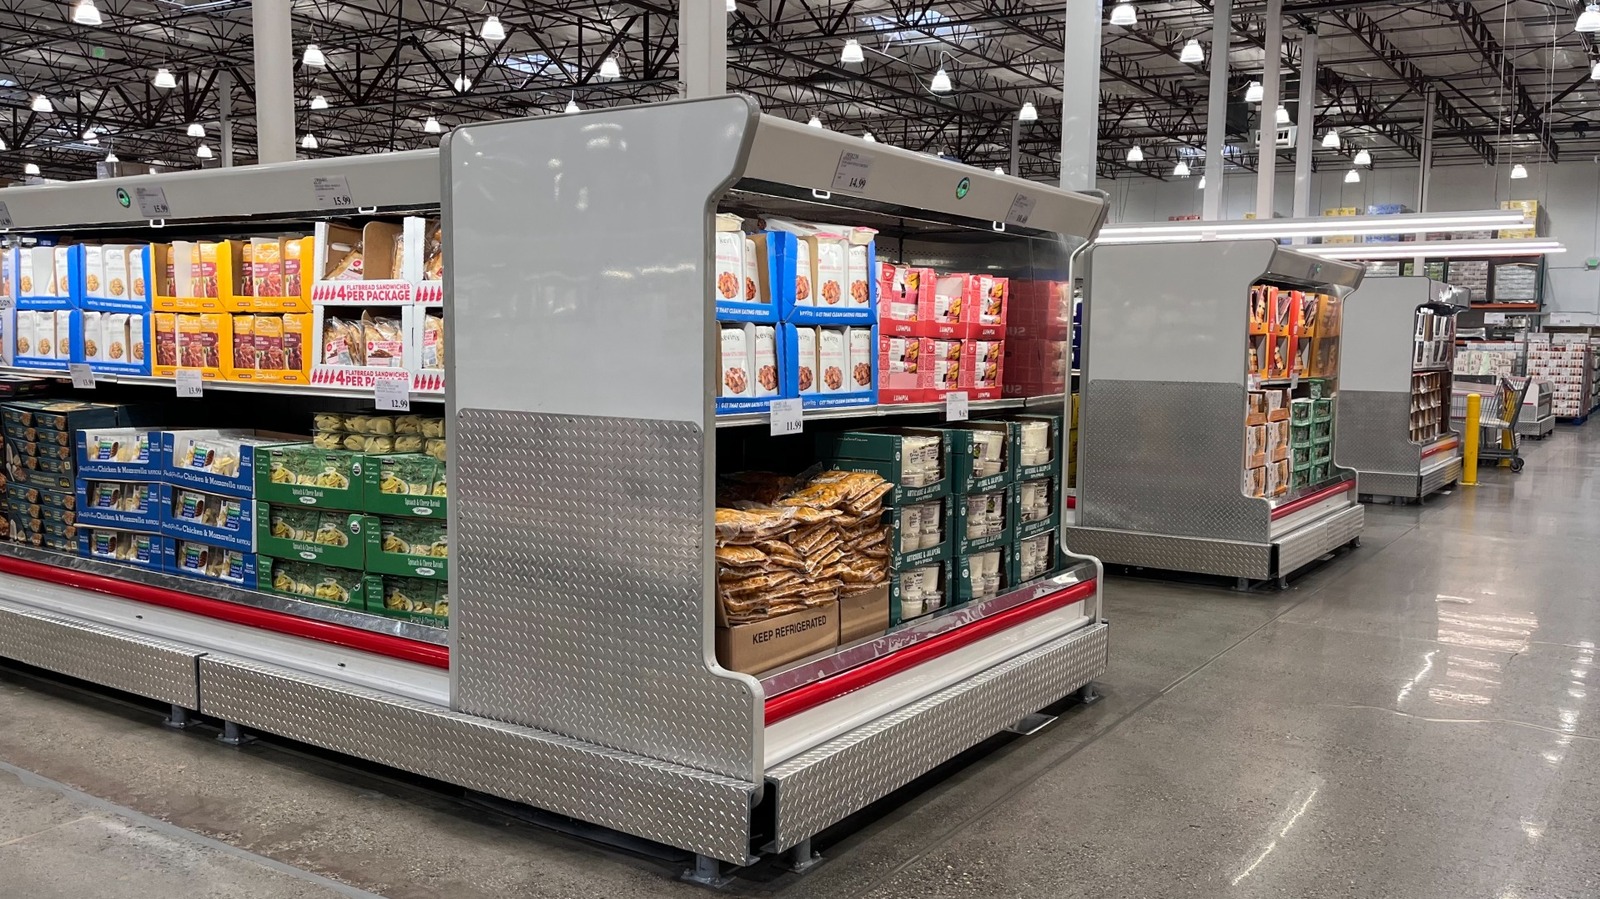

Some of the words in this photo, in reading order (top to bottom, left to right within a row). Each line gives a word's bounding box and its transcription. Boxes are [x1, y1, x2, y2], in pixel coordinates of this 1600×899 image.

[849, 178, 866, 188] 14.99
[333, 195, 351, 206] 15.99
[337, 286, 346, 300] 4
[347, 291, 365, 300] PER
[367, 290, 411, 300] PACKAGE
[336, 370, 345, 385] 4
[346, 377, 363, 386] PER
[189, 387, 201, 395] 13.99
[391, 400, 408, 408] 12.99
[786, 418, 802, 430] 11.99
[122, 466, 147, 474] Mozzarella
[184, 473, 204, 483] Chicken
[205, 476, 209, 484] &
[210, 477, 236, 489] Mozzarella
[96, 512, 116, 521] Chicken
[120, 515, 145, 524] Mozzarella
[182, 525, 203, 536] Chicken
[208, 530, 236, 542] Mozzarella
[753, 630, 774, 645] KEEP
[776, 615, 827, 638] REFRIGERATED
